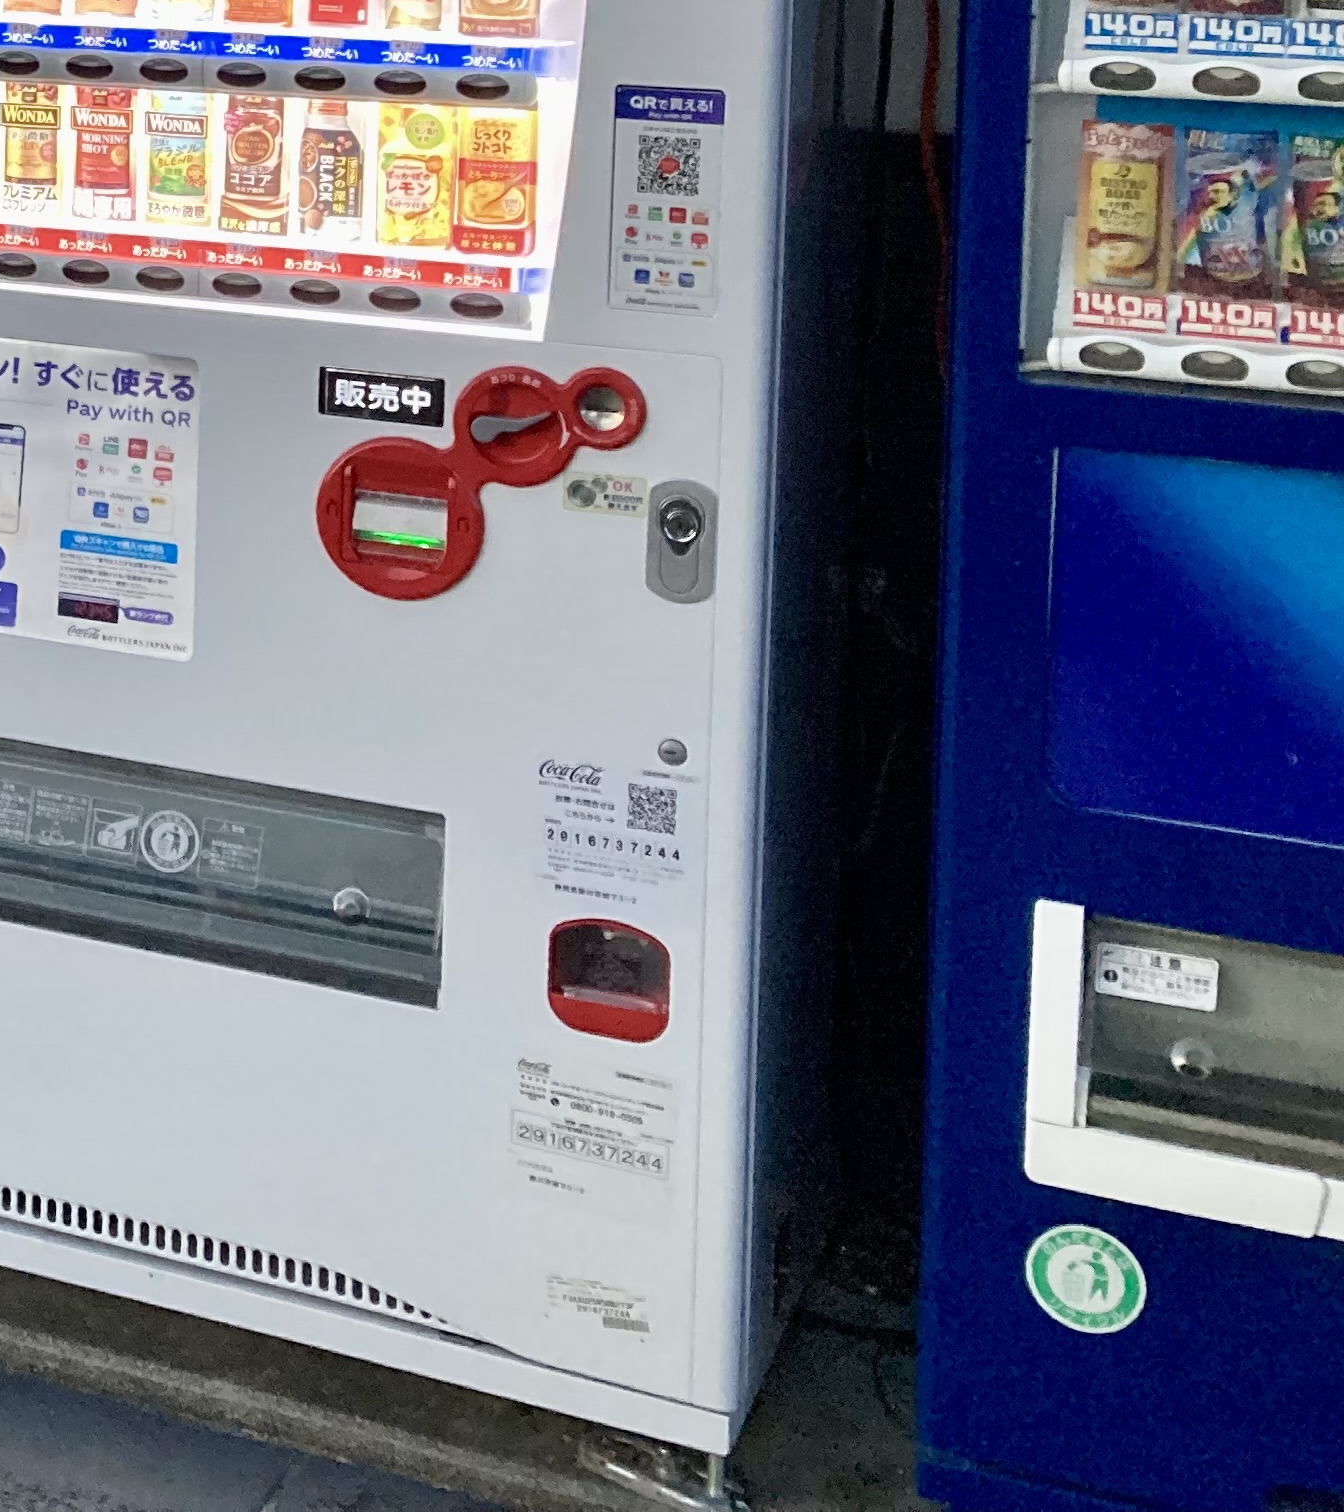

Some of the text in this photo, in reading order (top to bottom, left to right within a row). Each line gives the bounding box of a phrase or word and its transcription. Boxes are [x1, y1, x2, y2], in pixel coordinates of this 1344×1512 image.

[1088, 13, 1175, 39] 140円
[1193, 16, 1283, 43] 140円
[2, 104, 56, 124] WONDA
[629, 95, 714, 114] QRで買える!
[74, 108, 128, 128] WONDA
[148, 114, 202, 134] WONDA
[81, 132, 128, 144] MORNING
[473, 126, 513, 142] じっくり
[81, 143, 109, 155] SHOT
[472, 141, 514, 156] コトコト
[157, 155, 194, 168] BLEND
[230, 172, 274, 187] ココア
[319, 154, 335, 203] BLACK
[386, 179, 433, 197] レモン
[1100, 177, 1148, 189] BISTRO
[1105, 189, 1141, 200] BOSS
[1076, 292, 1163, 319] 140円
[1184, 299, 1273, 327] 140円
[33, 360, 196, 403] すぐに使える
[333, 378, 433, 416] 販売中
[66, 398, 192, 429] Pay with QR
[612, 480, 633, 493] OK
[539, 759, 605, 786] Coca-Cola
[517, 1125, 663, 1172] 2916737244
